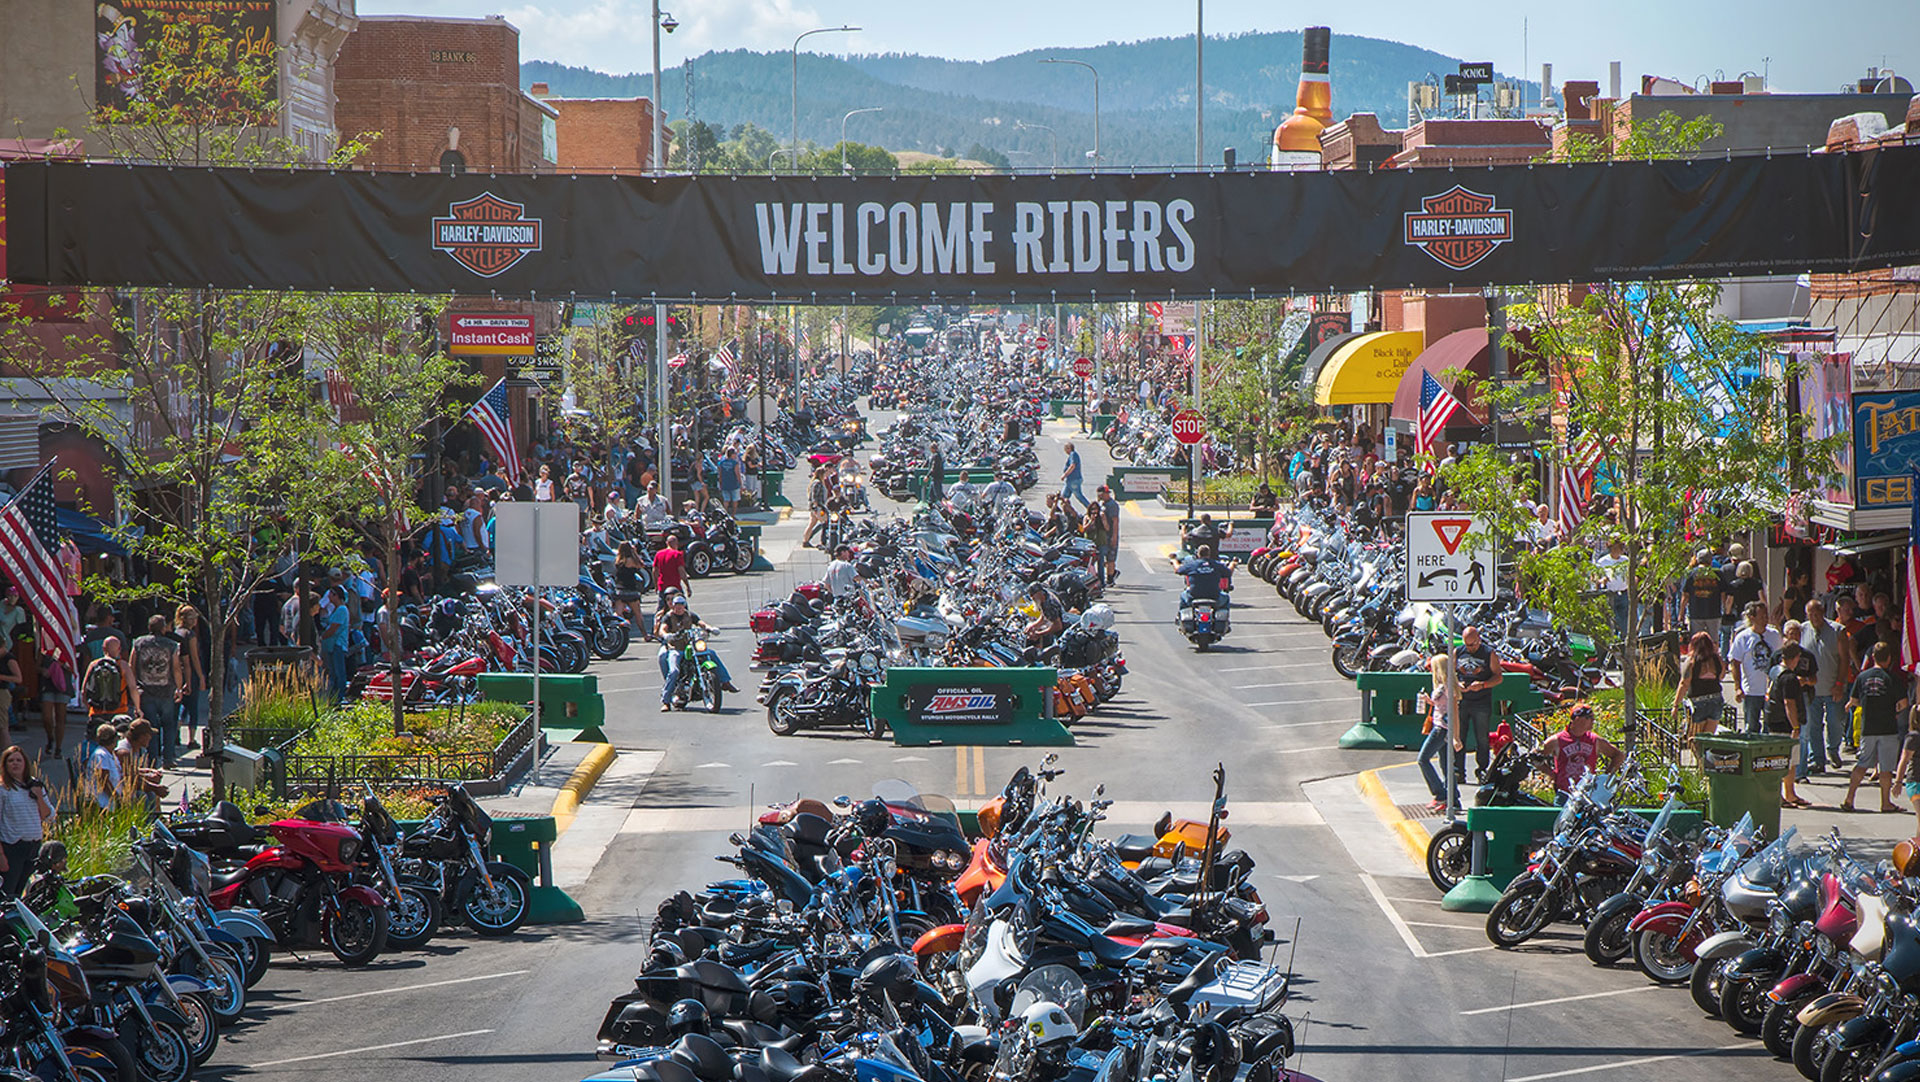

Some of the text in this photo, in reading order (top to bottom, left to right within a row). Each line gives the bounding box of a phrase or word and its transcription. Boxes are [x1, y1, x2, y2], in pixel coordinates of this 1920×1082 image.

[442, 51, 465, 62] BANK
[463, 202, 512, 220] MOTOR
[1434, 195, 1483, 213] MOTOR
[441, 225, 534, 243] HARLEY-DAVIDSON
[1412, 218, 1505, 237] HARLEY-DAVIDSON
[755, 199, 1195, 275] WELCOME RIDERS
[462, 248, 512, 268] CYCLES
[1434, 240, 1484, 262] CYCLES
[626, 316, 655, 325] 6:49
[1373, 348, 1393, 358] Black
[1174, 420, 1205, 433] STOP
[1417, 555, 1446, 566] HERE
[1444, 580, 1458, 592] TO
[925, 694, 996, 713] AMSOIL
